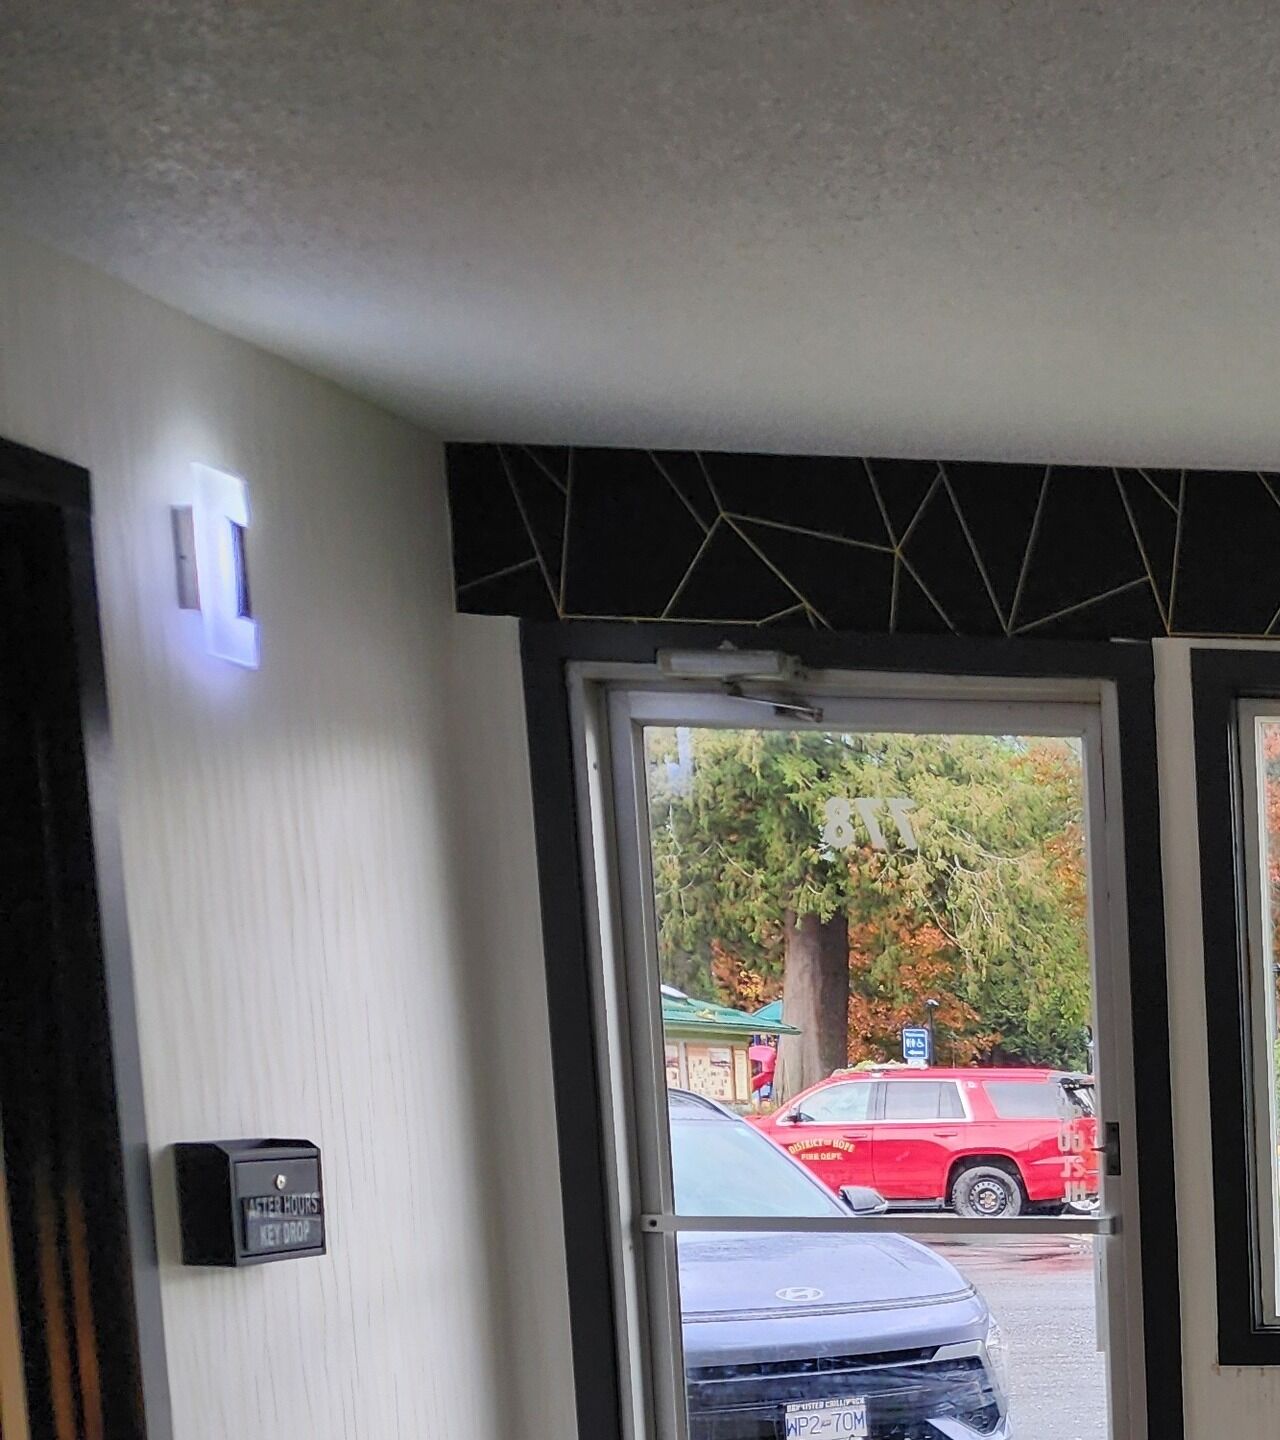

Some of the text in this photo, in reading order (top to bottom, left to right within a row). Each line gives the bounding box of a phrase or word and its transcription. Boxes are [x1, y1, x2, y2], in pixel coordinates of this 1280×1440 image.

[788, 1138, 823, 1154] DISTRICT
[832, 1140, 855, 1152] HOPE
[249, 1193, 319, 1216] AFTER HOURS
[260, 1222, 310, 1246] KEY DROP
[786, 1411, 865, 1437] WP2 70M
